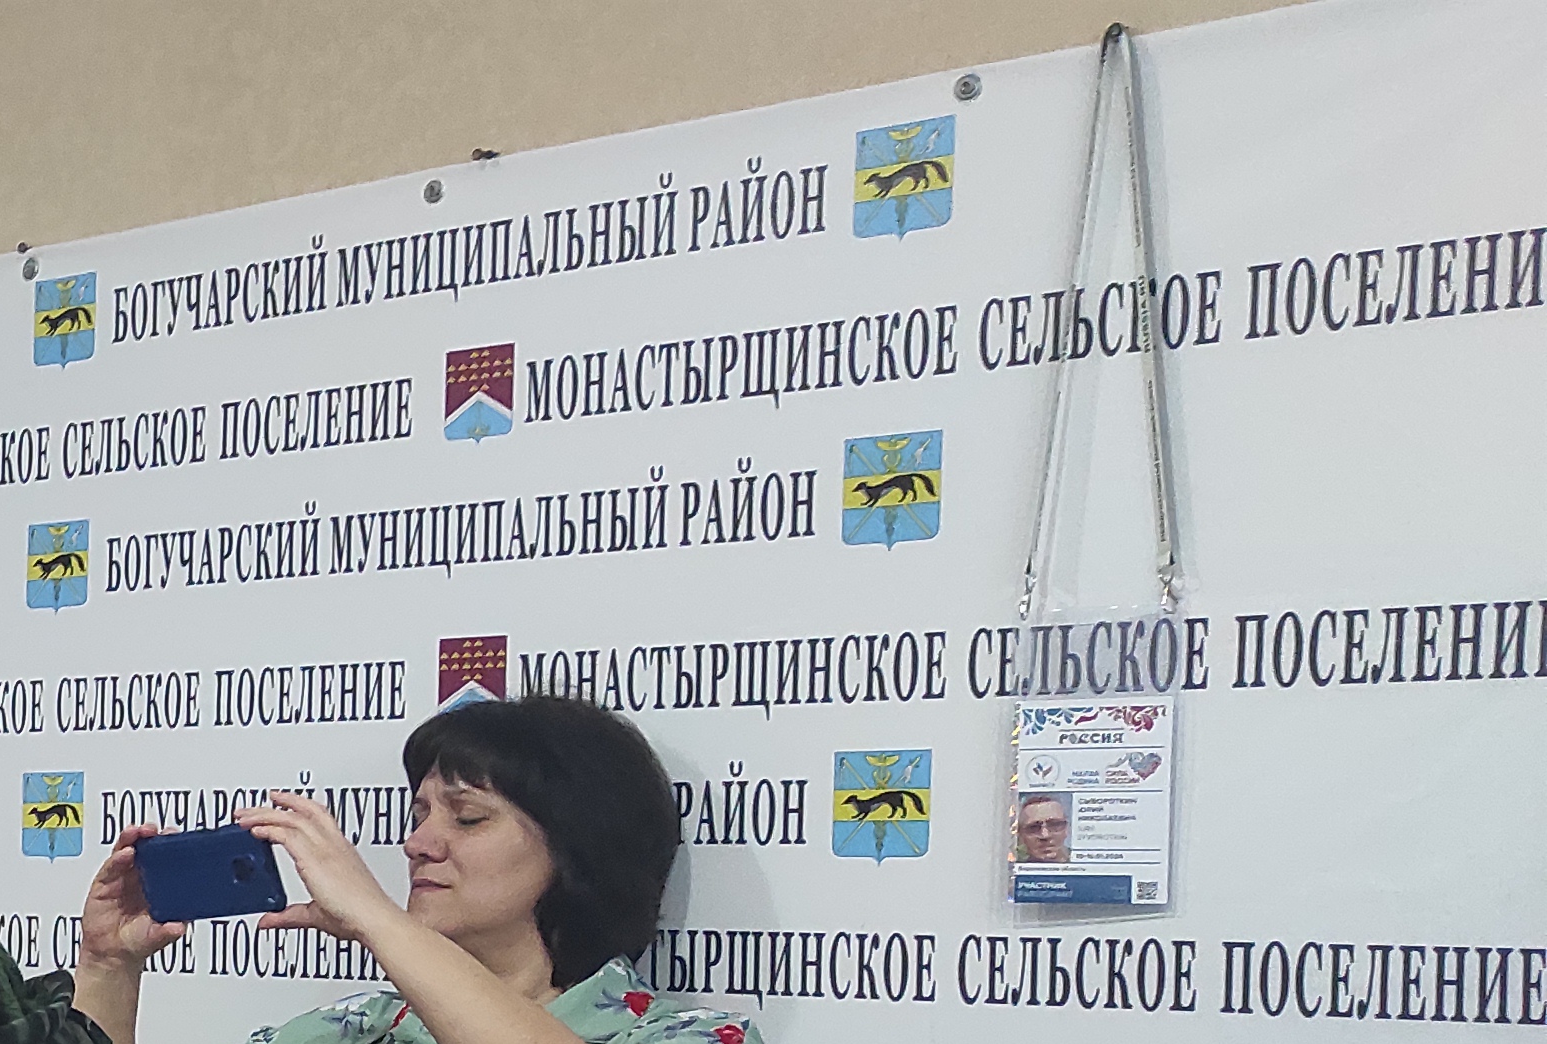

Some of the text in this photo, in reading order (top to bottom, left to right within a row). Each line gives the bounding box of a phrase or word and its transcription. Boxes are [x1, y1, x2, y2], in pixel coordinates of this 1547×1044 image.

[112, 157, 828, 344] БОГУЧАРСКИЙ МУНИЦИПАЛЬНЫЙ РАЙОН
[525, 304, 959, 423] МОНАСТЫРЩИНСКОЕ
[979, 270, 1222, 374] СЕЛЬСКОЕ
[63, 406, 206, 480] СЕЛЬСКОЕ
[219, 378, 413, 460] ПОСЕЛЕНИЕ
[107, 458, 817, 593] БОГУЧАРСКИЙ МУНИЦИПАЛЬНЫЙ РАЙОН
[57, 673, 201, 733] СЕЛЬСКОЕ
[214, 661, 407, 727] ПОСЕЛЕНИЕ
[519, 633, 946, 718] МОНАСТЫРЩИНСКОЕ
[969, 618, 1210, 698] СЕЛЬСКОЕ
[673, 761, 807, 845] РАЙОН
[209, 918, 392, 982] ПОСЕЛЕНИ
[958, 937, 1197, 1013] СЕЛЬСКОЕ
[1220, 940, 1547, 1026] ПОСЕЛЕНИЕ
